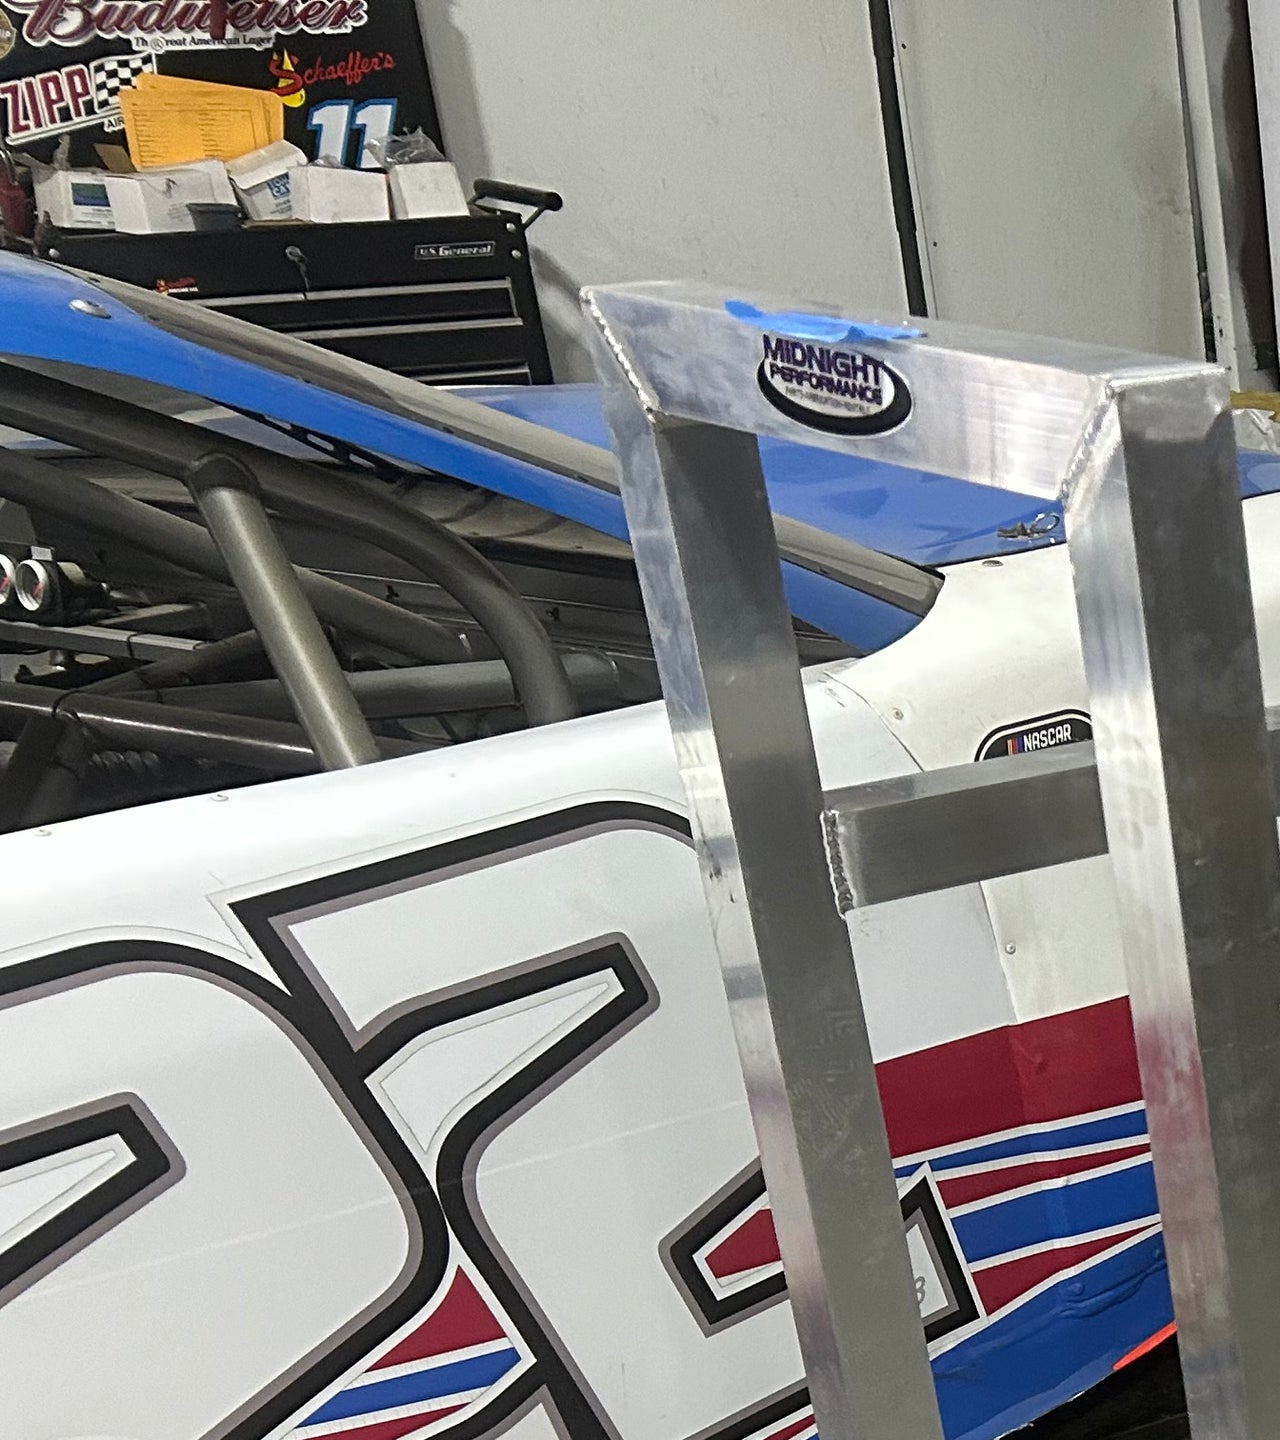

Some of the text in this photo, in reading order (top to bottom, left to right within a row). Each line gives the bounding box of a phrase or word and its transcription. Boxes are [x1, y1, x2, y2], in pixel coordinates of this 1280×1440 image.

[268, 51, 396, 97] Schaeffer's
[306, 97, 399, 170] 11
[438, 244, 491, 256] General
[763, 334, 884, 386] MIDNIGHT
[769, 362, 883, 406] PERFORMANCE
[1022, 723, 1072, 753] NASCAR
